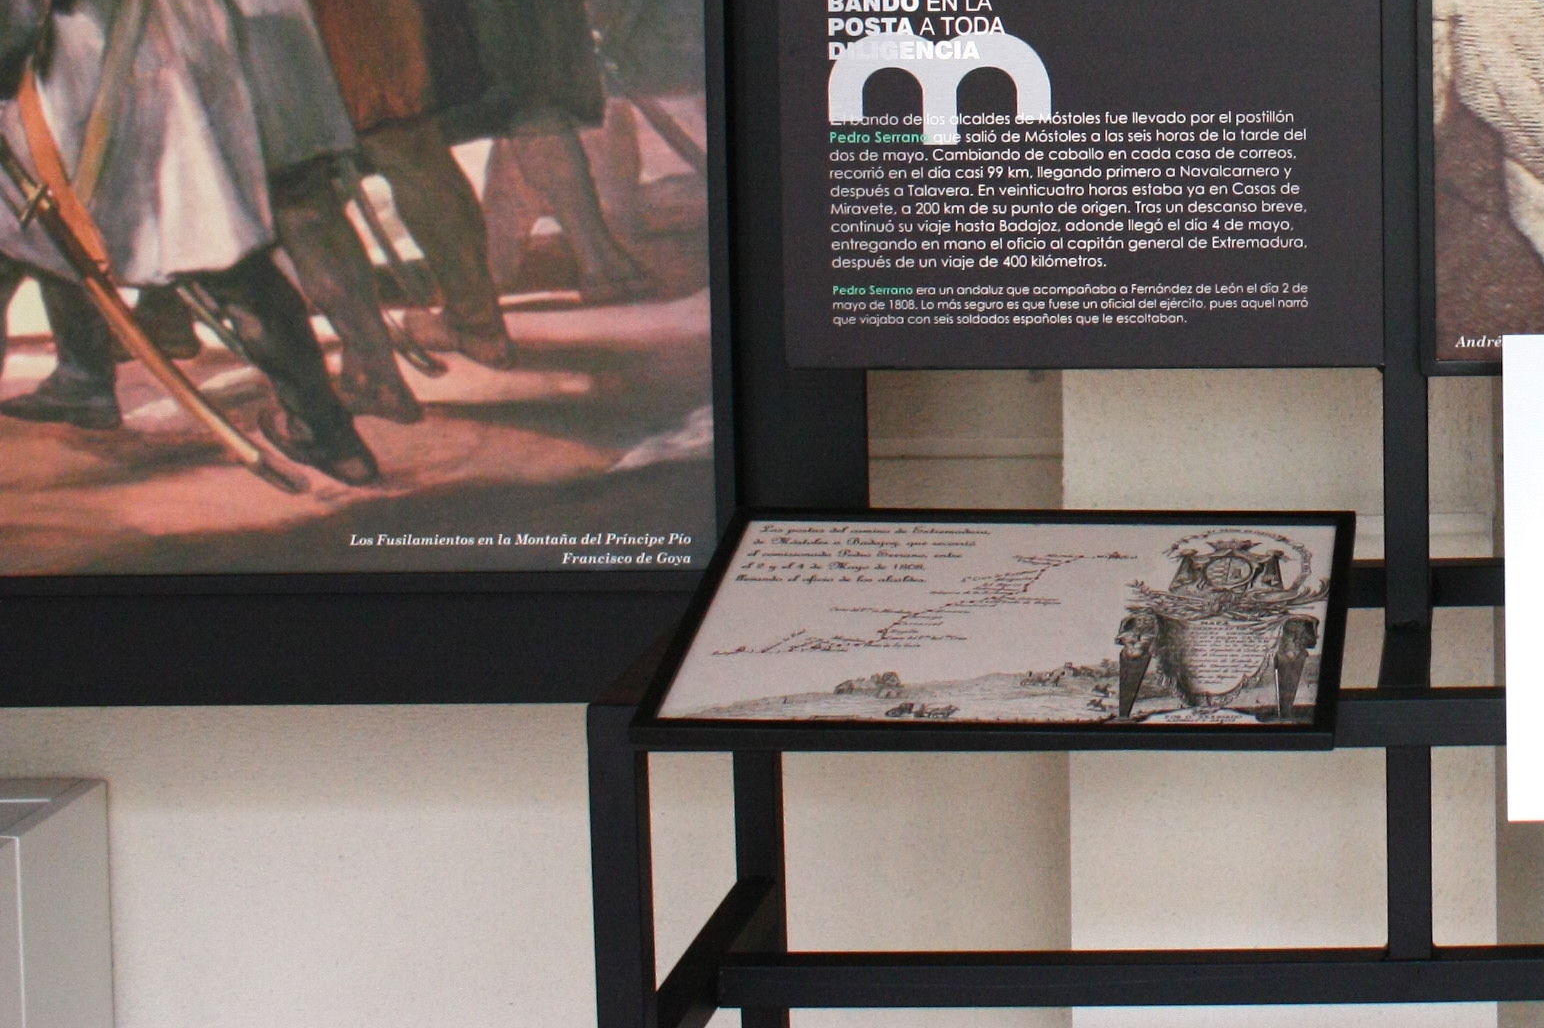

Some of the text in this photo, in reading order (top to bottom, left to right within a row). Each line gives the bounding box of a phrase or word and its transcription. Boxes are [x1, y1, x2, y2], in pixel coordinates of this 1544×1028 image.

[828, 17, 1005, 36] POSTA A TODA
[830, 128, 1306, 145] Pedro Serrano que salió de Móstoles a las seis horas de la tarde del
[832, 255, 1106, 270] después de un viaje de 400 kilómetros.
[833, 316, 856, 326] que
[860, 315, 903, 326] viajaba
[907, 316, 930, 324] con
[934, 314, 953, 324] seis
[957, 314, 1009, 324] soldados
[1012, 313, 1072, 325] españoles
[1076, 315, 1098, 325] que
[1102, 313, 1112, 323] le
[1455, 335, 1502, 348] André
[350, 533, 690, 546] Los Fusilamientos en la Montaña del Príncipe Pío
[562, 552, 690, 565] Francisco de Goya
